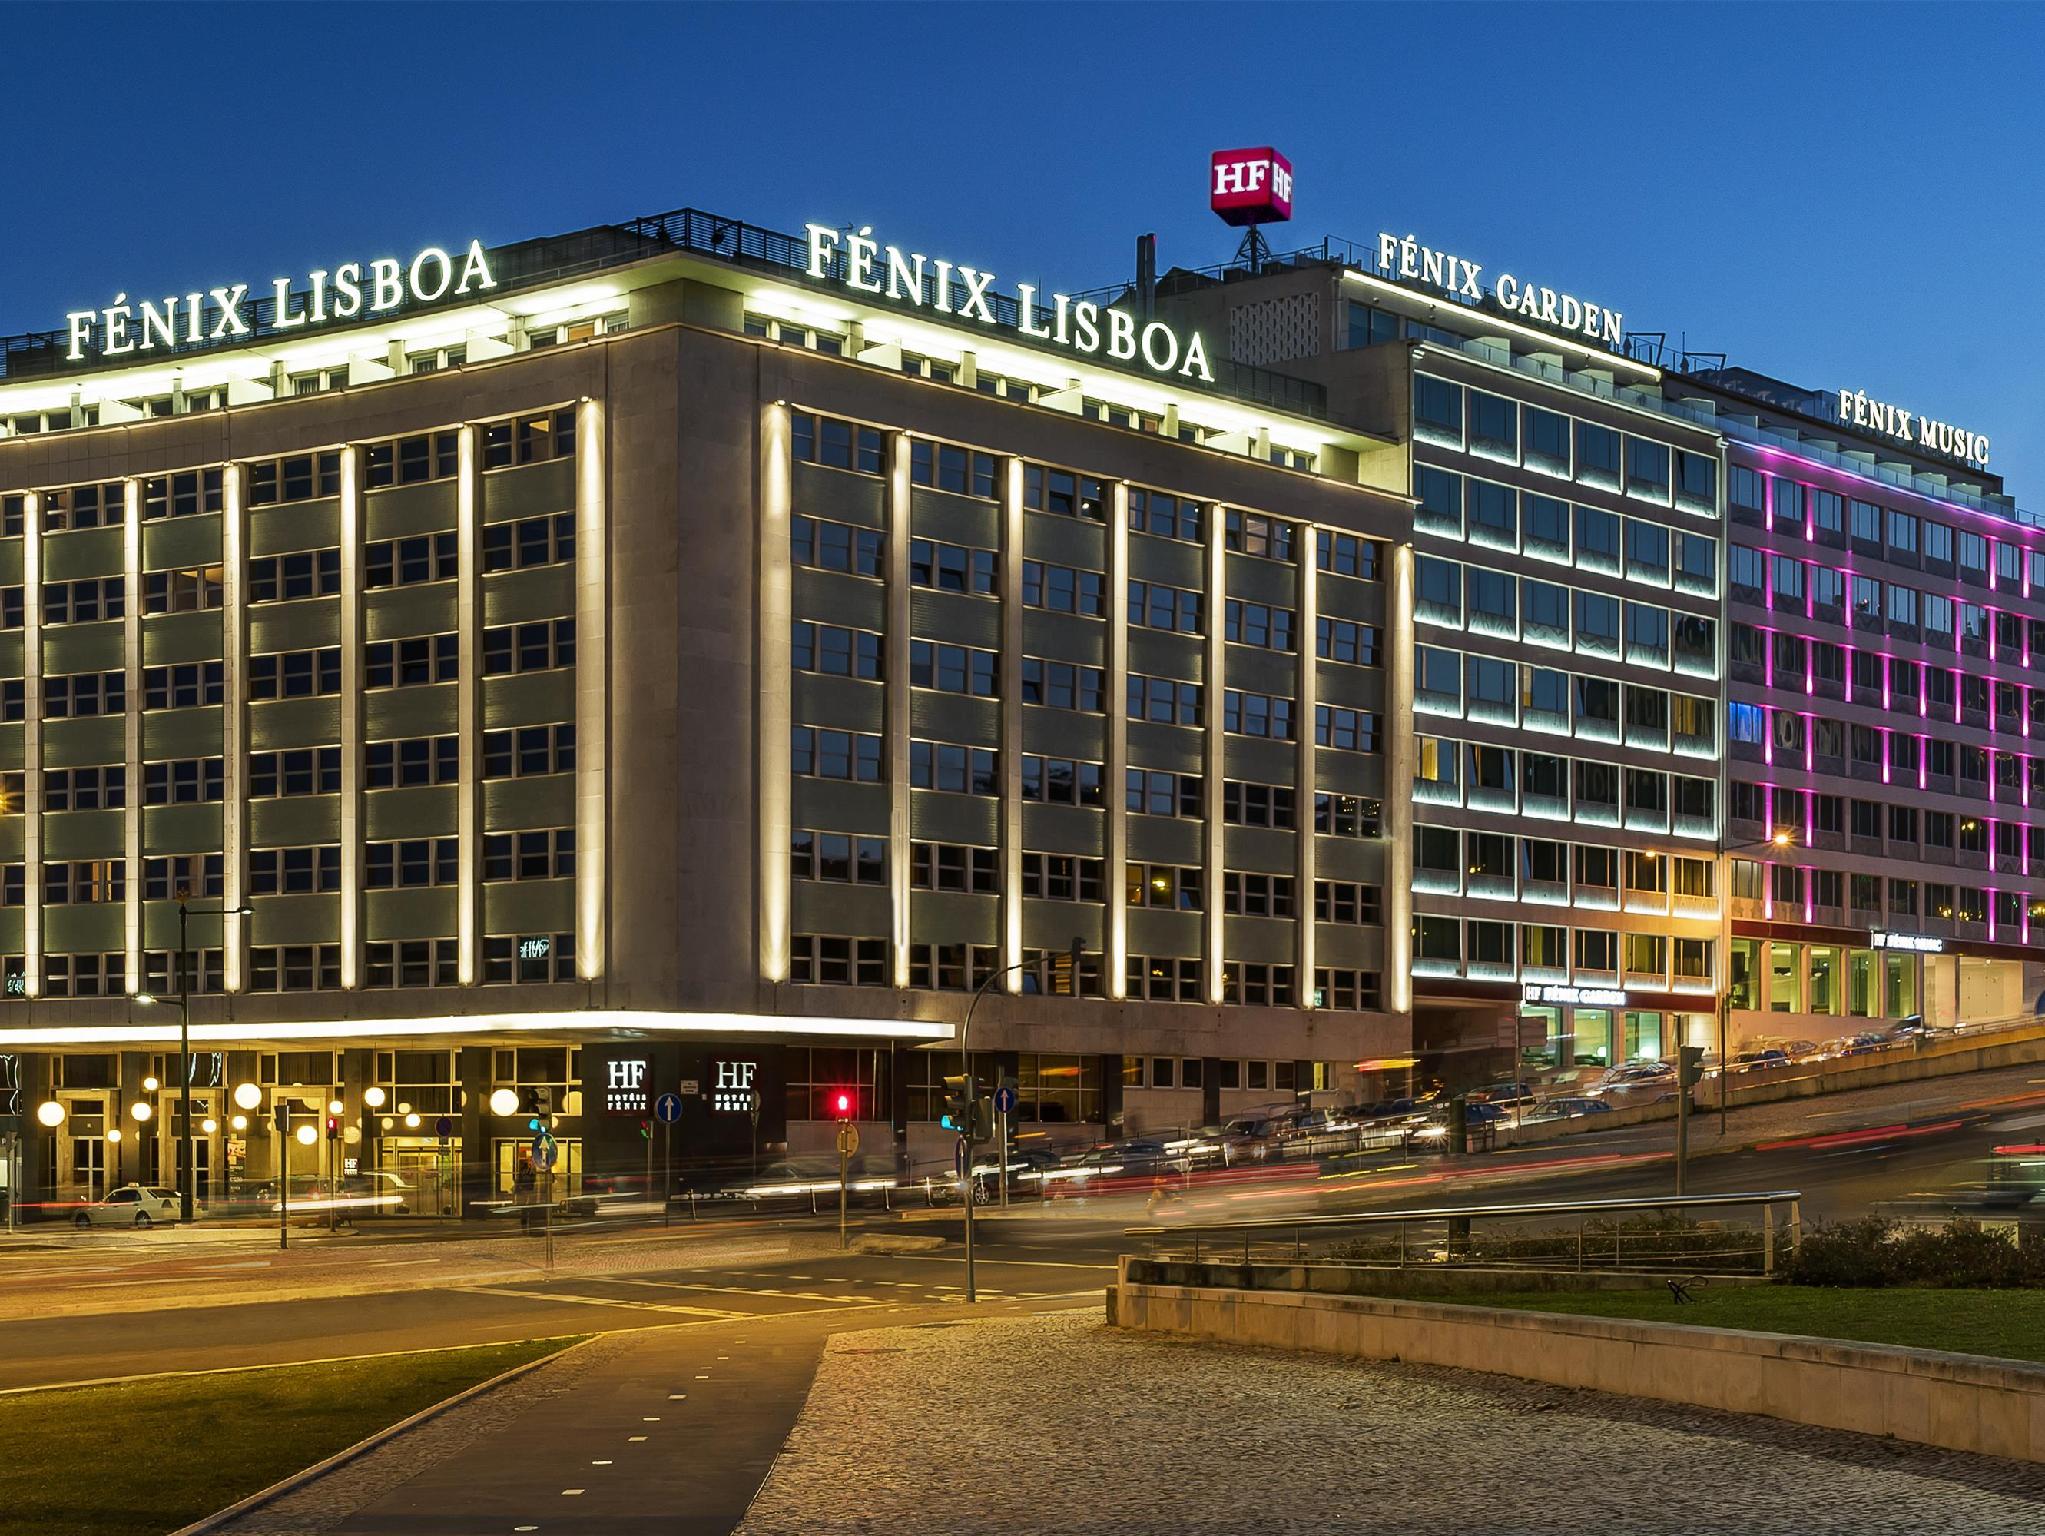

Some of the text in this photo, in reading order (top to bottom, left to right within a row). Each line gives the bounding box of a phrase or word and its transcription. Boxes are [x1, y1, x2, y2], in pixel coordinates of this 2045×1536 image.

[1213, 160, 1270, 194] HF
[1272, 162, 1292, 203] HF
[65, 239, 498, 360] FÉNIX LISBOA
[805, 222, 1216, 383] FÉNIX LISBOA
[1378, 232, 1623, 344] FÉNIX GARDEN
[1839, 389, 1990, 464] FÉNIX MUSIC
[607, 1060, 647, 1089] HF
[715, 1061, 757, 1089] HF
[607, 1101, 646, 1111] FÉNIX
[715, 1101, 753, 1111] FÉNI
